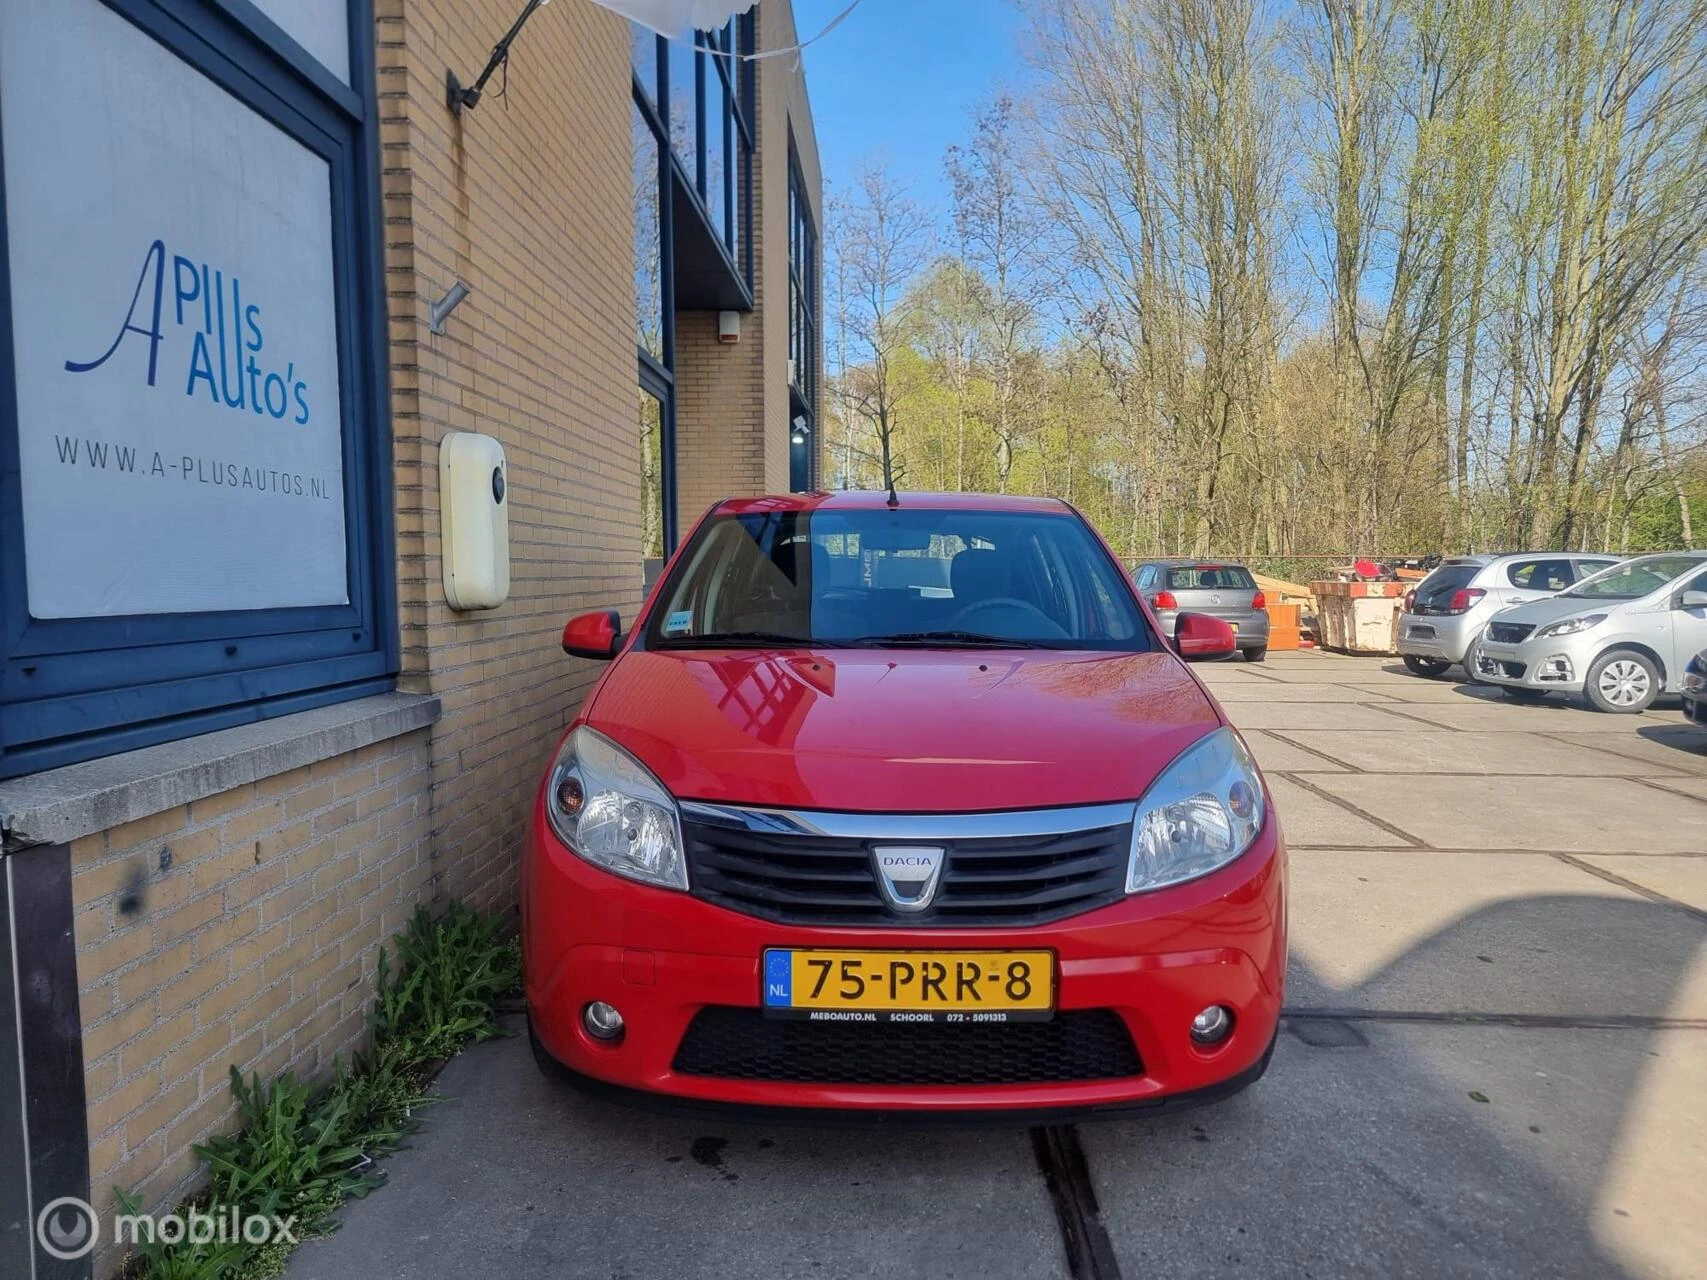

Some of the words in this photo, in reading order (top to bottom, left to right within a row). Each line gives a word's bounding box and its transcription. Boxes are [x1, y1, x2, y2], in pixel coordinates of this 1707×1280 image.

[64, 239, 166, 387] A
[55, 434, 331, 500] WWW.A-PLUSAUTOS.NL
[882, 855, 932, 867] DACIA
[769, 983, 789, 997] NL
[806, 958, 1033, 1003] 75-PRR-8
[810, 1011, 877, 1022] MEBOAUTO.NL
[890, 1012, 934, 1022] SCHOORL
[946, 1013, 964, 1022] 072
